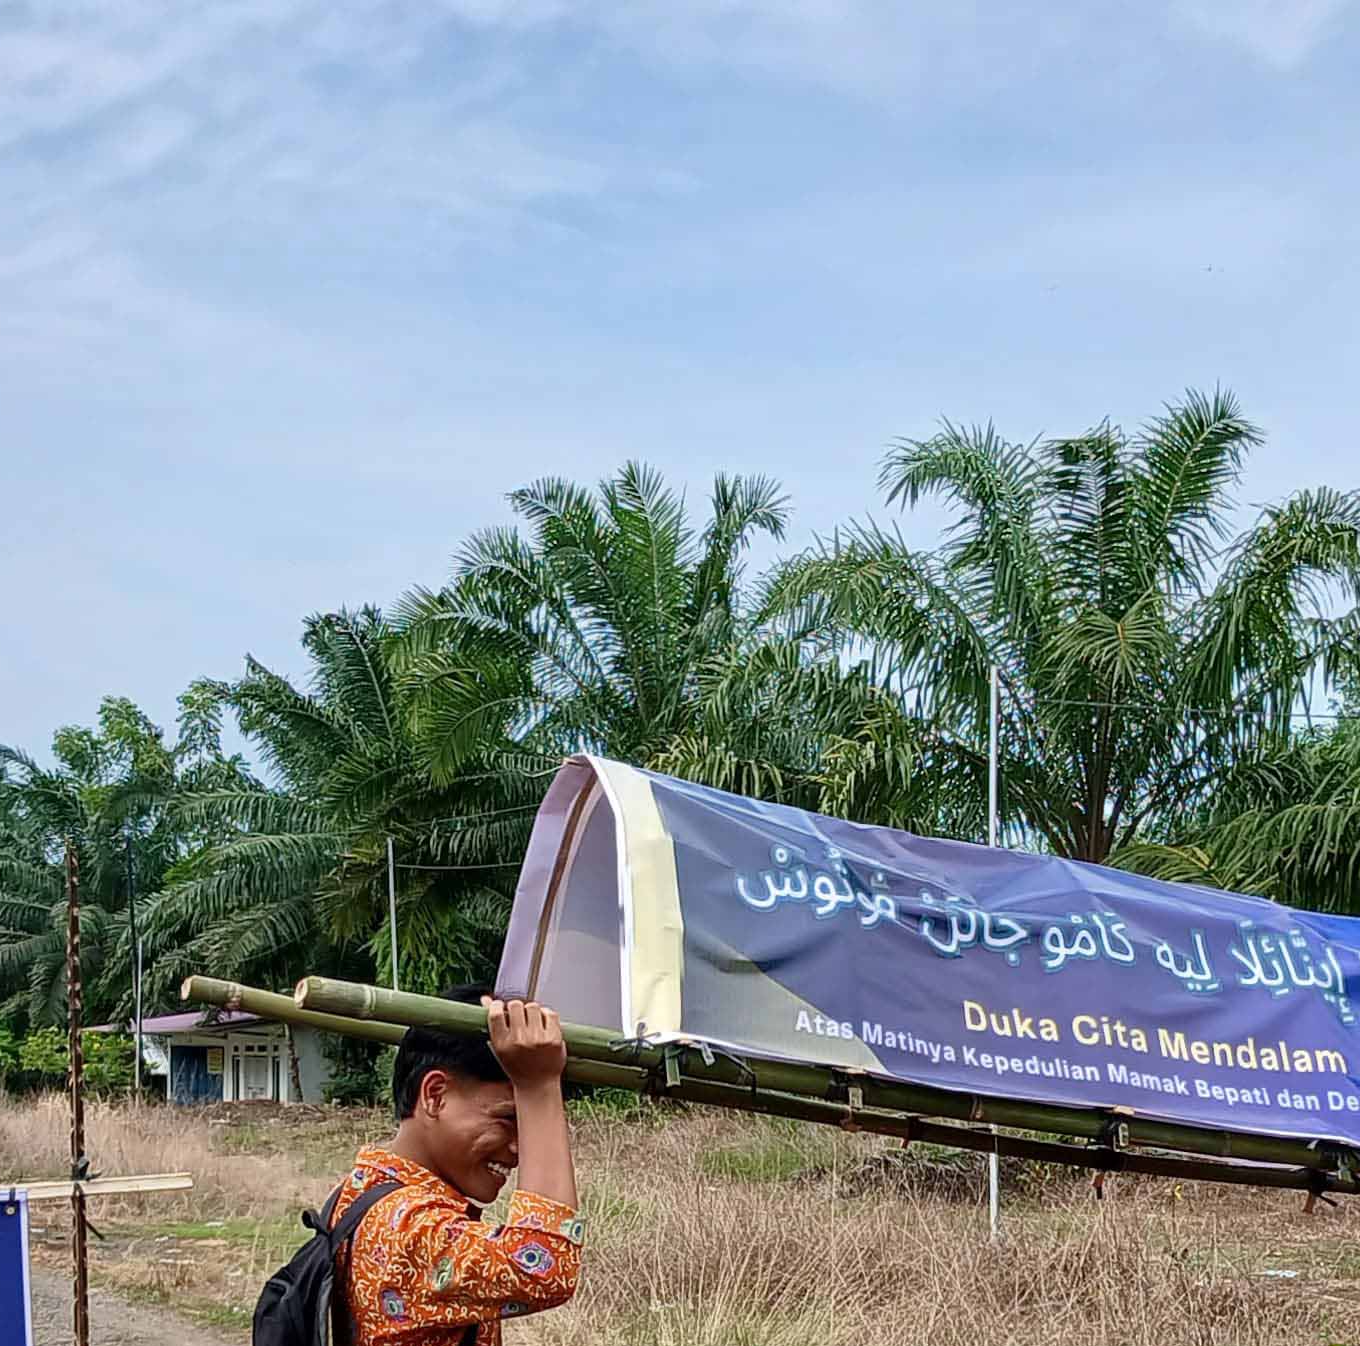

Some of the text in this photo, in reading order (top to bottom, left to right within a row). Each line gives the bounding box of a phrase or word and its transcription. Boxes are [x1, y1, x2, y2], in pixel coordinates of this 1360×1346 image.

[795, 1010, 854, 1040] Atas
[862, 1020, 957, 1064] Matinya
[962, 1045, 1101, 1082] Kepedulian
[1107, 1062, 1190, 1096] Mamak
[1277, 1087, 1321, 1111] dan
[963, 1000, 1348, 1075] Duka Cita Mendalam
